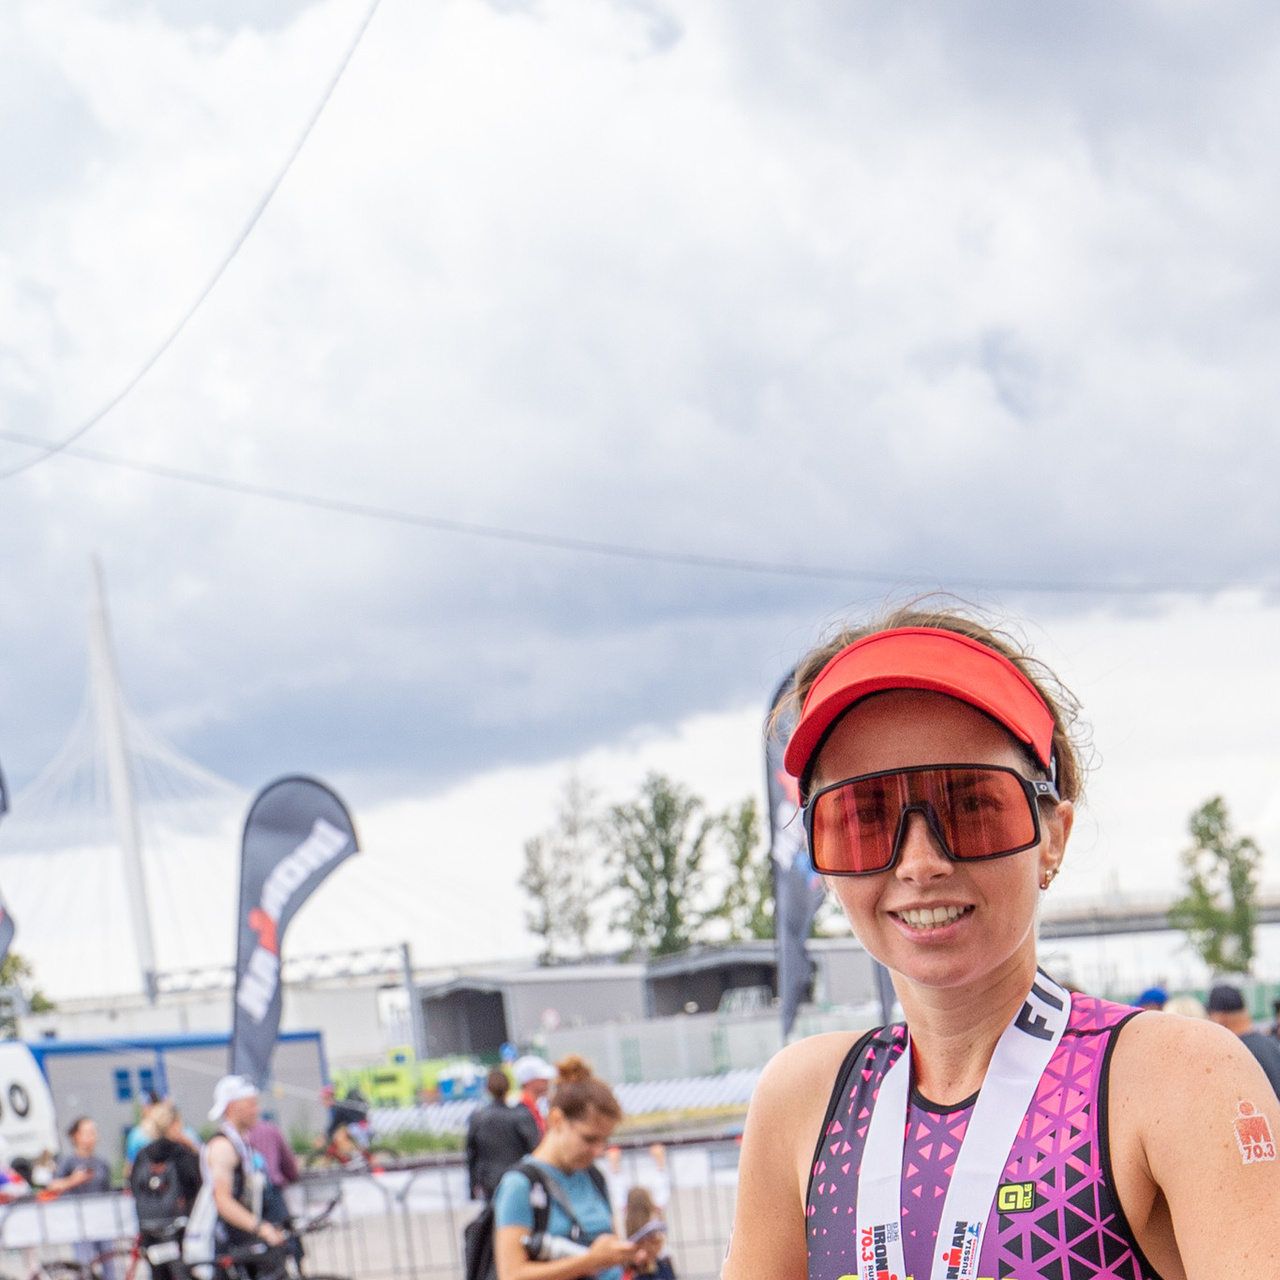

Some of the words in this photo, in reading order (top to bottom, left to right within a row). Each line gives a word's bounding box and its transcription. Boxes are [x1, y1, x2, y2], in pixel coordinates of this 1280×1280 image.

[1243, 1144, 1275, 1160] 70.3
[860, 1226, 875, 1263] 70.3
[961, 1239, 973, 1275] RUSSIA
